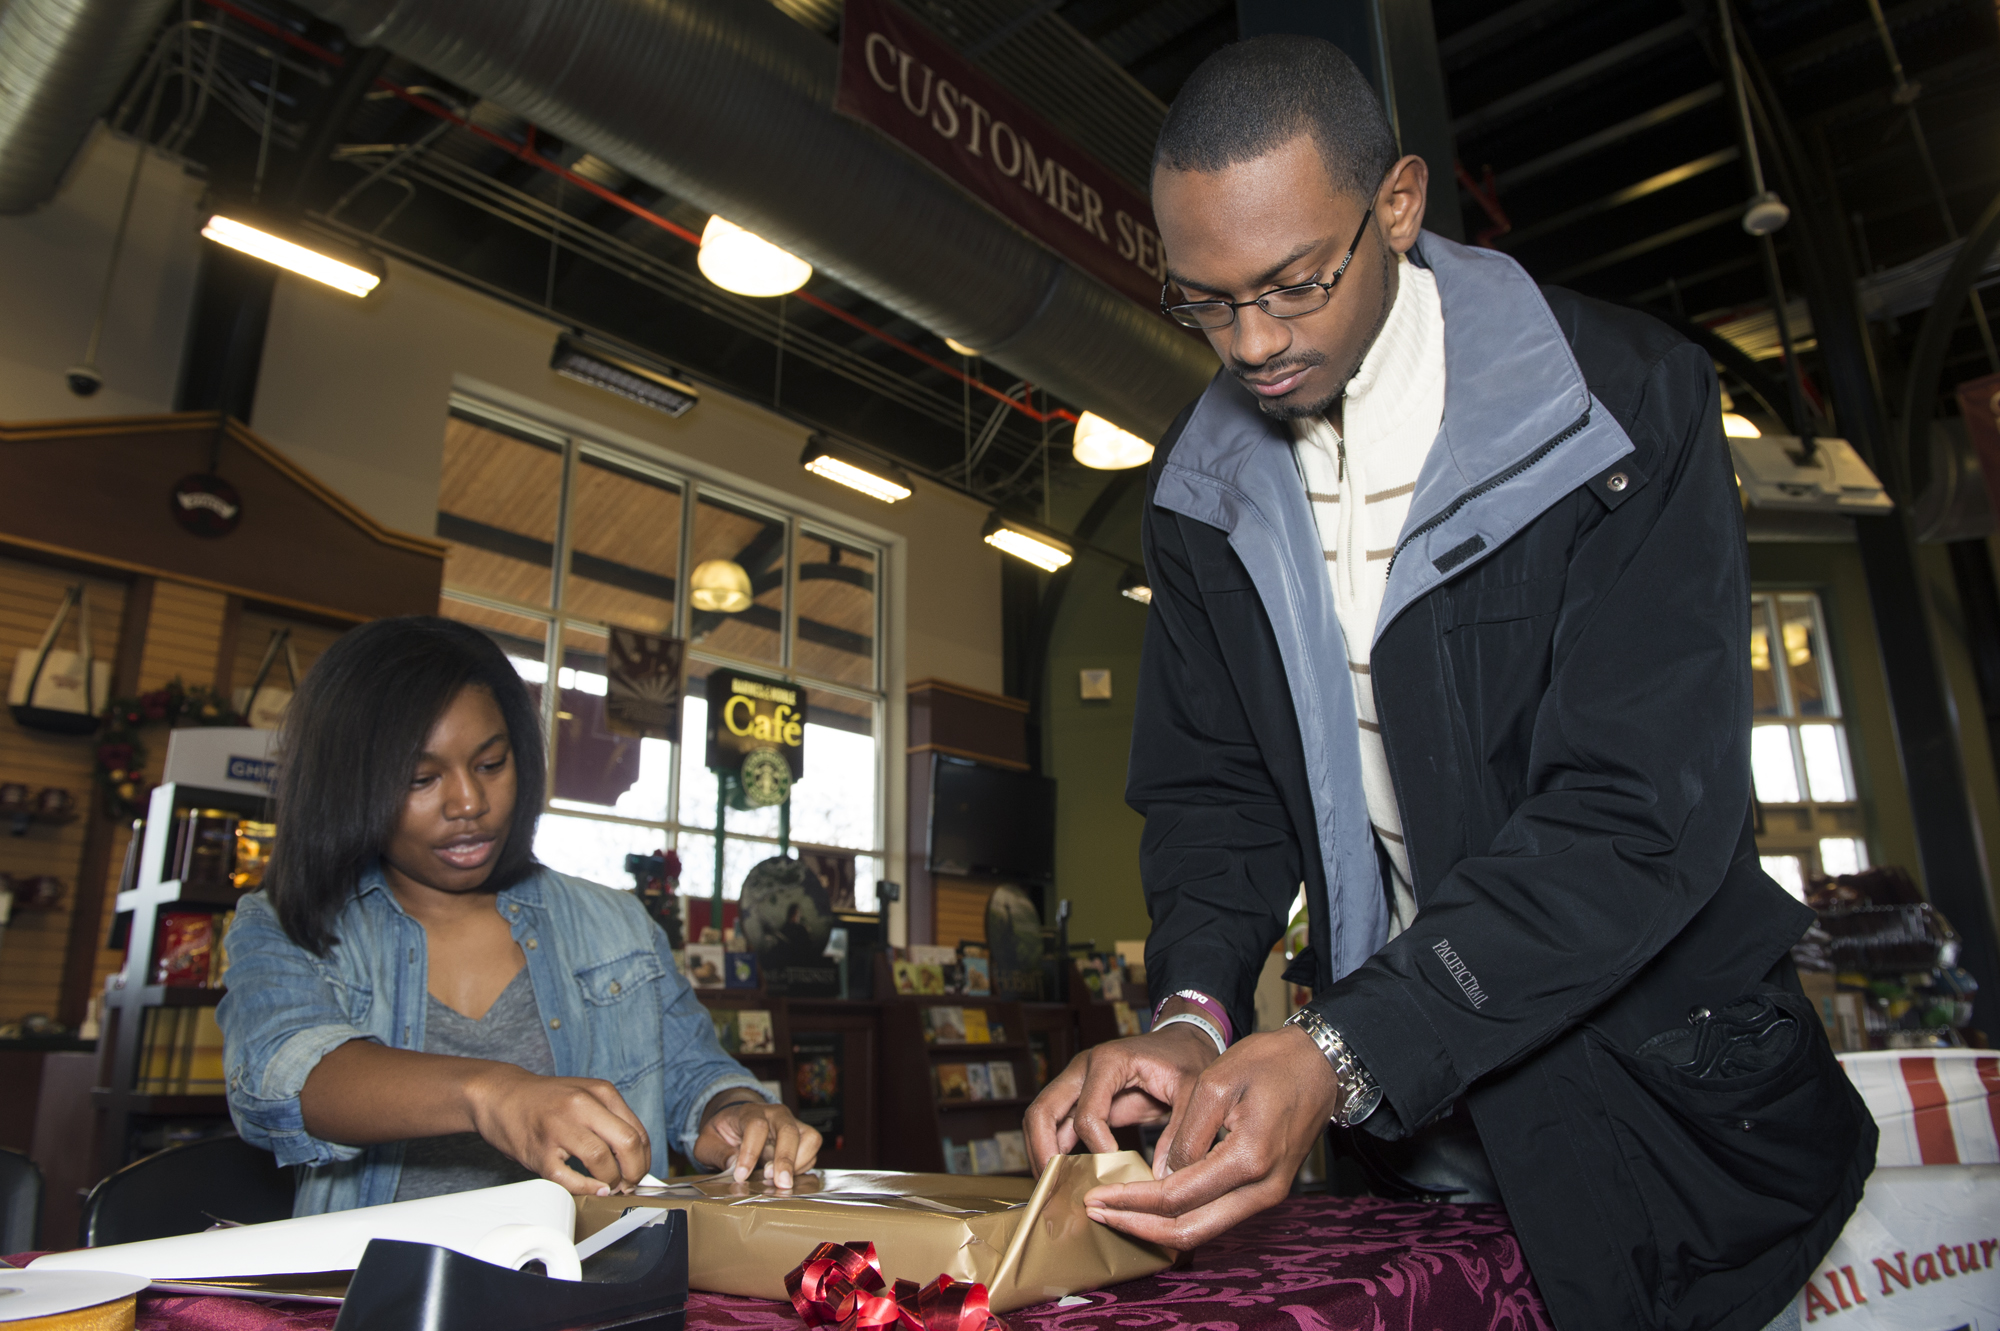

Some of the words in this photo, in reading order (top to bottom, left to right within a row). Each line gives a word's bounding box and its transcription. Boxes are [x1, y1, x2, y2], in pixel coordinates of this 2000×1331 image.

[865, 32, 1110, 244] CUSTOMER
[724, 695, 803, 747] Café
[1432, 938, 1472, 982] PACIFIC
[1462, 975, 1489, 1010] TRAIL
[1806, 1264, 1868, 1323] All
[1872, 1237, 2000, 1296] Natur
